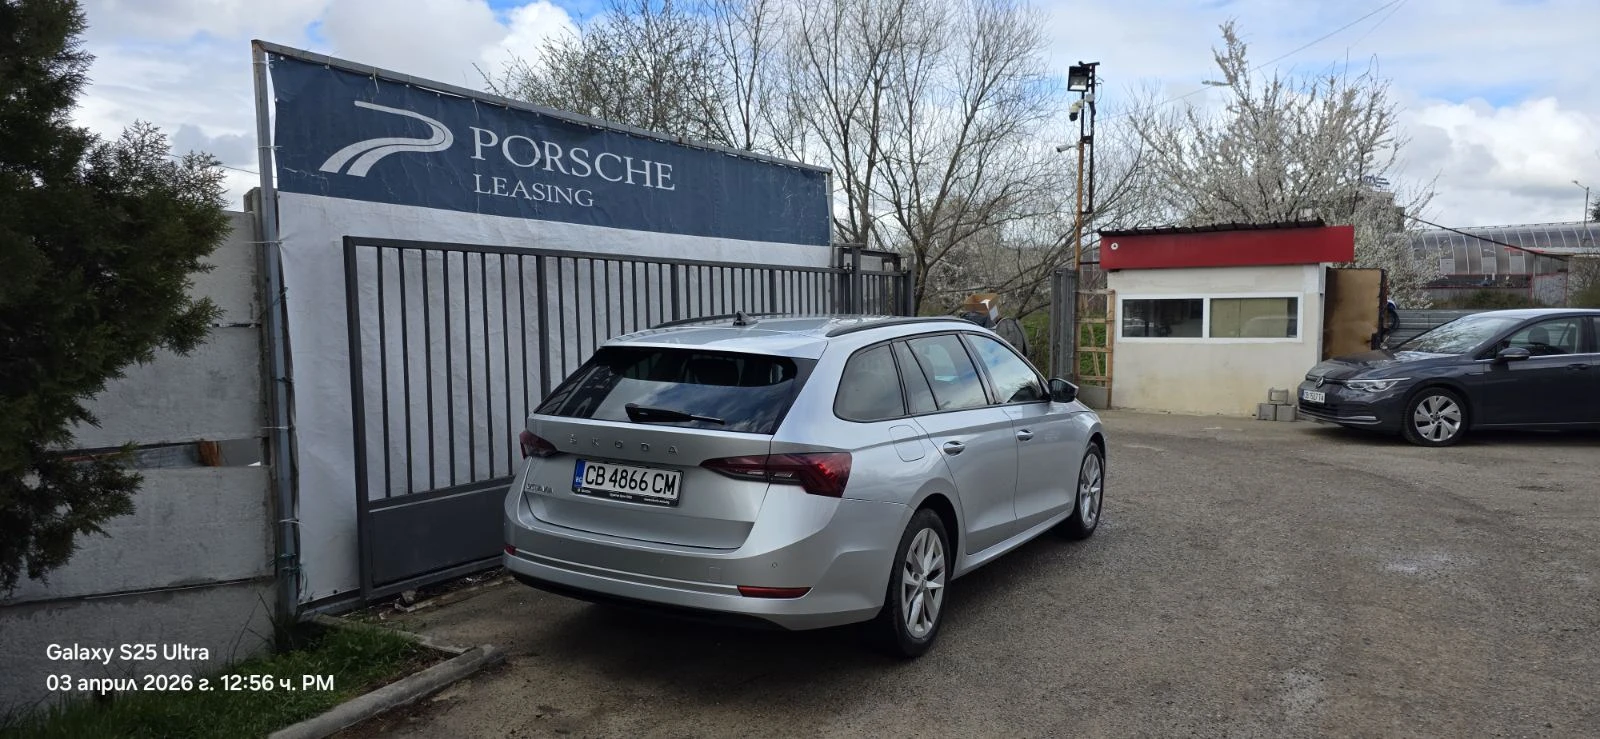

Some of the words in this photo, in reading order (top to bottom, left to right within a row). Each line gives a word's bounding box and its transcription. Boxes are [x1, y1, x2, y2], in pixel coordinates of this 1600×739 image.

[469, 126, 676, 191] PORSCHE
[473, 173, 594, 207] LEASING
[585, 465, 606, 486] CB
[608, 468, 648, 491] 4866
[652, 473, 677, 495] CM
